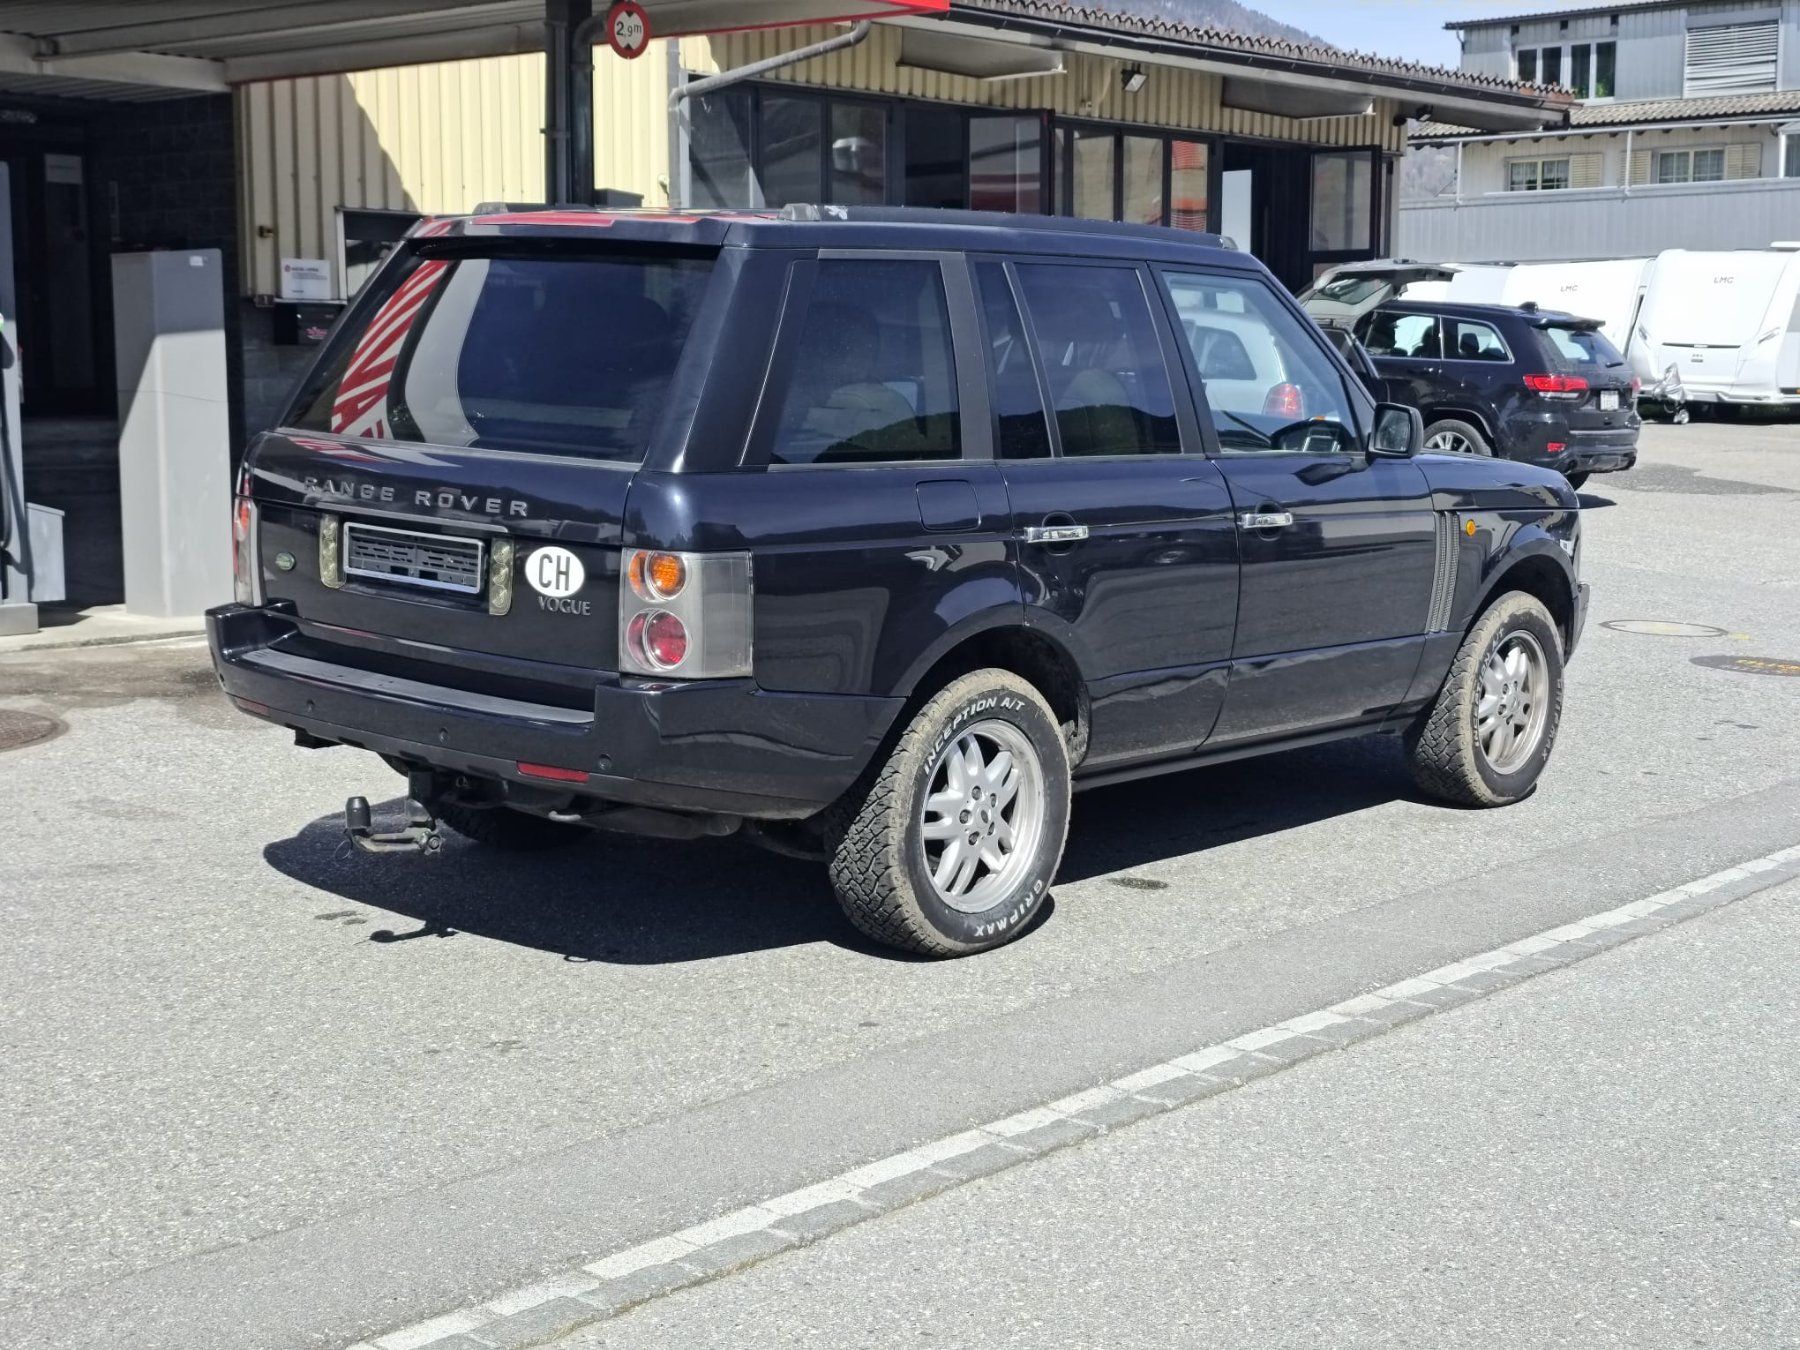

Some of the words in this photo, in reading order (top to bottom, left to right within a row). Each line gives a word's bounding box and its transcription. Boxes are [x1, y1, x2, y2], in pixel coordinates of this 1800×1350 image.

[1713, 276, 1734, 284] LMC
[304, 477, 395, 501] RANGE
[415, 490, 528, 517] ROVER
[538, 553, 571, 591] CH
[537, 596, 591, 616] VOGUE
[923, 697, 998, 775] INCEPTION
[1000, 697, 1026, 711] A/T
[974, 879, 1043, 937] GRIPMAX
